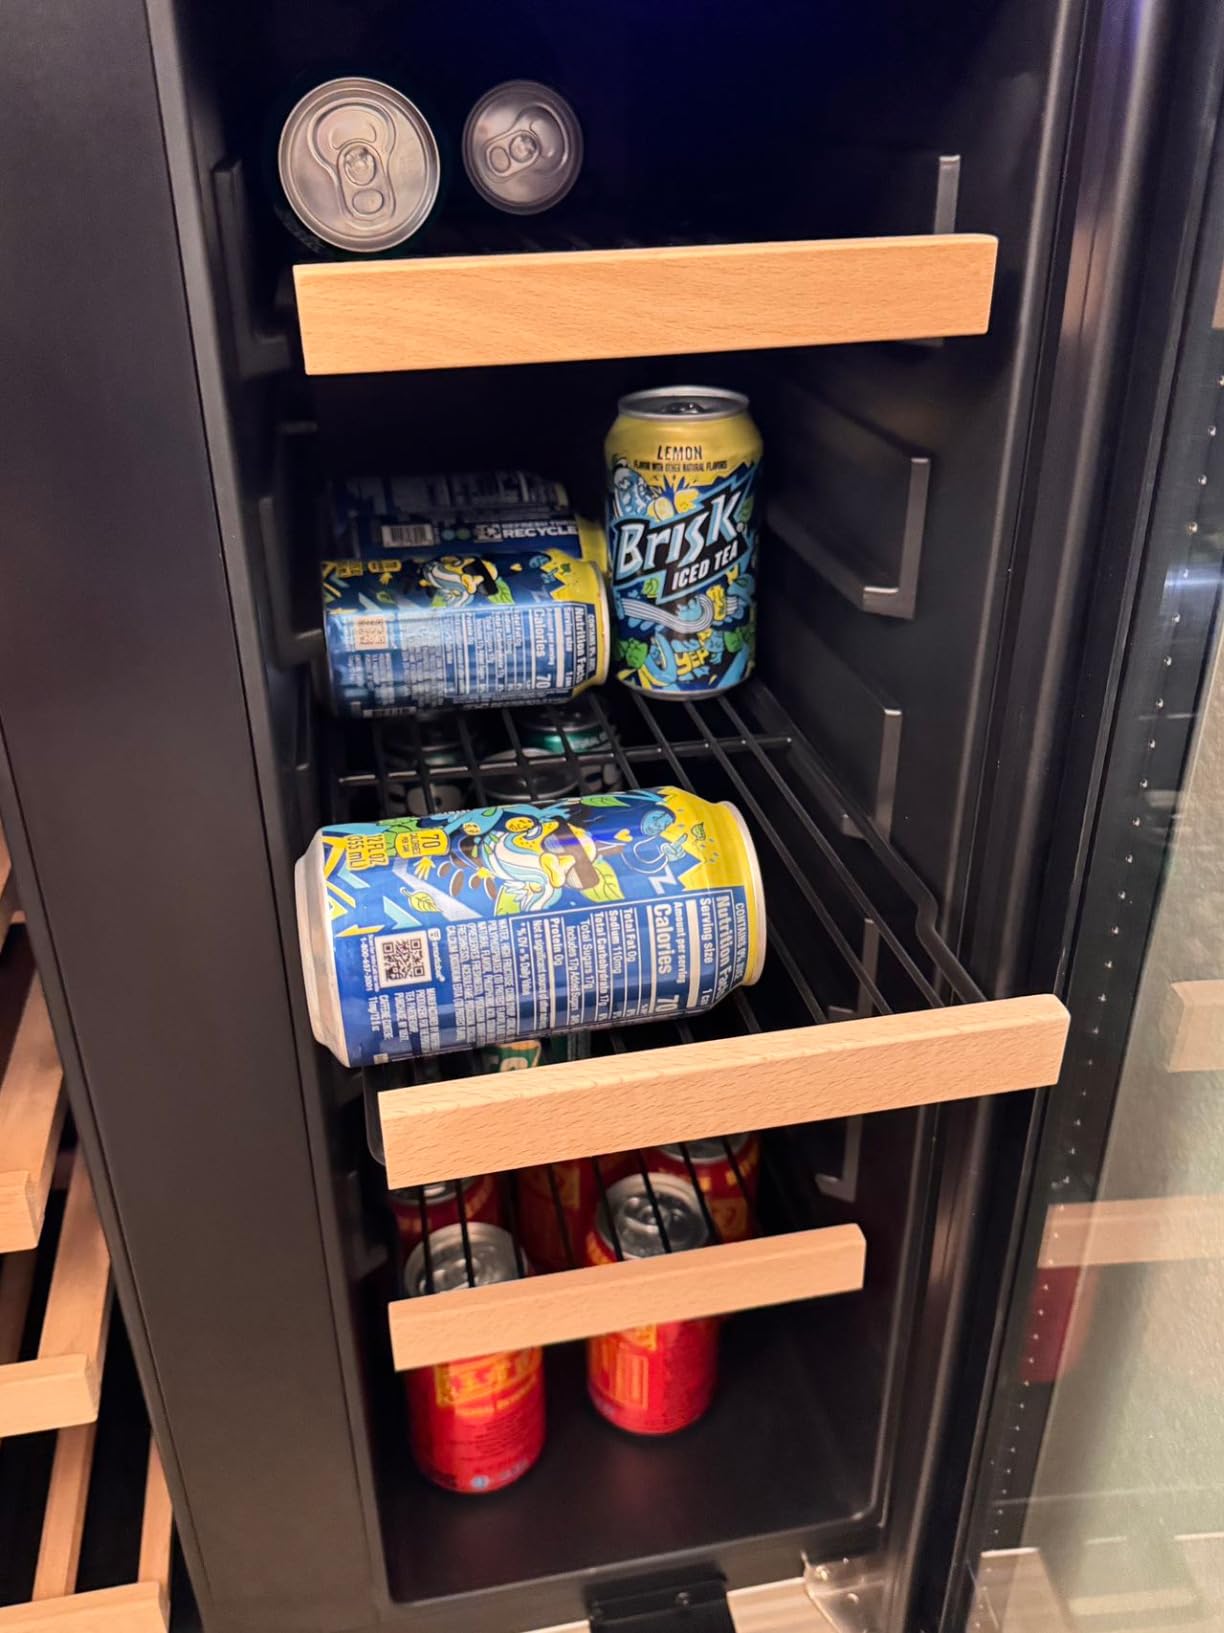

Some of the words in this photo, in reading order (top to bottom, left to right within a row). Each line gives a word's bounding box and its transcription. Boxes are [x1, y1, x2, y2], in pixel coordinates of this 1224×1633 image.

[656, 444, 703, 460] LEMON
[503, 526, 578, 539] RECYCLE
[671, 560, 711, 591] ICED
[714, 540, 738, 571] TEA
[534, 609, 547, 657] Calories
[575, 607, 586, 656] Nutrition
[536, 673, 551, 689] 70
[576, 657, 586, 683] Facts
[367, 844, 384, 852] FL
[411, 833, 420, 855] CALORIES
[421, 834, 440, 848] 70
[368, 854, 385, 865] OZ
[594, 912, 606, 936] Total
[609, 910, 621, 944] Sodium
[624, 908, 635, 932] Total
[674, 902, 686, 937] Amount
[700, 897, 714, 940] Serving
[736, 903, 746, 948] CONTAINS
[550, 918, 562, 952] Protein
[566, 926, 578, 957] Includes
[580, 920, 591, 942] Total
[627, 934, 636, 949] Fat
[654, 904, 675, 974] Calories
[716, 896, 733, 967] Nutrition
[627, 951, 636, 962] 0g
[676, 939, 685, 953] per
[704, 943, 715, 964] size
[736, 948, 745, 962] 0%
[553, 954, 564, 966] 0g
[568, 959, 579, 970] 17g
[582, 944, 593, 974] Sugars
[597, 938, 608, 993] Carbohydrate
[612, 946, 622, 974] 110mg
[676, 955, 687, 984] serving
[519, 962, 529, 979] Daily
[584, 976, 594, 990] 17g
[598, 995, 609, 1006] 17g
[655, 995, 679, 1013] 70
